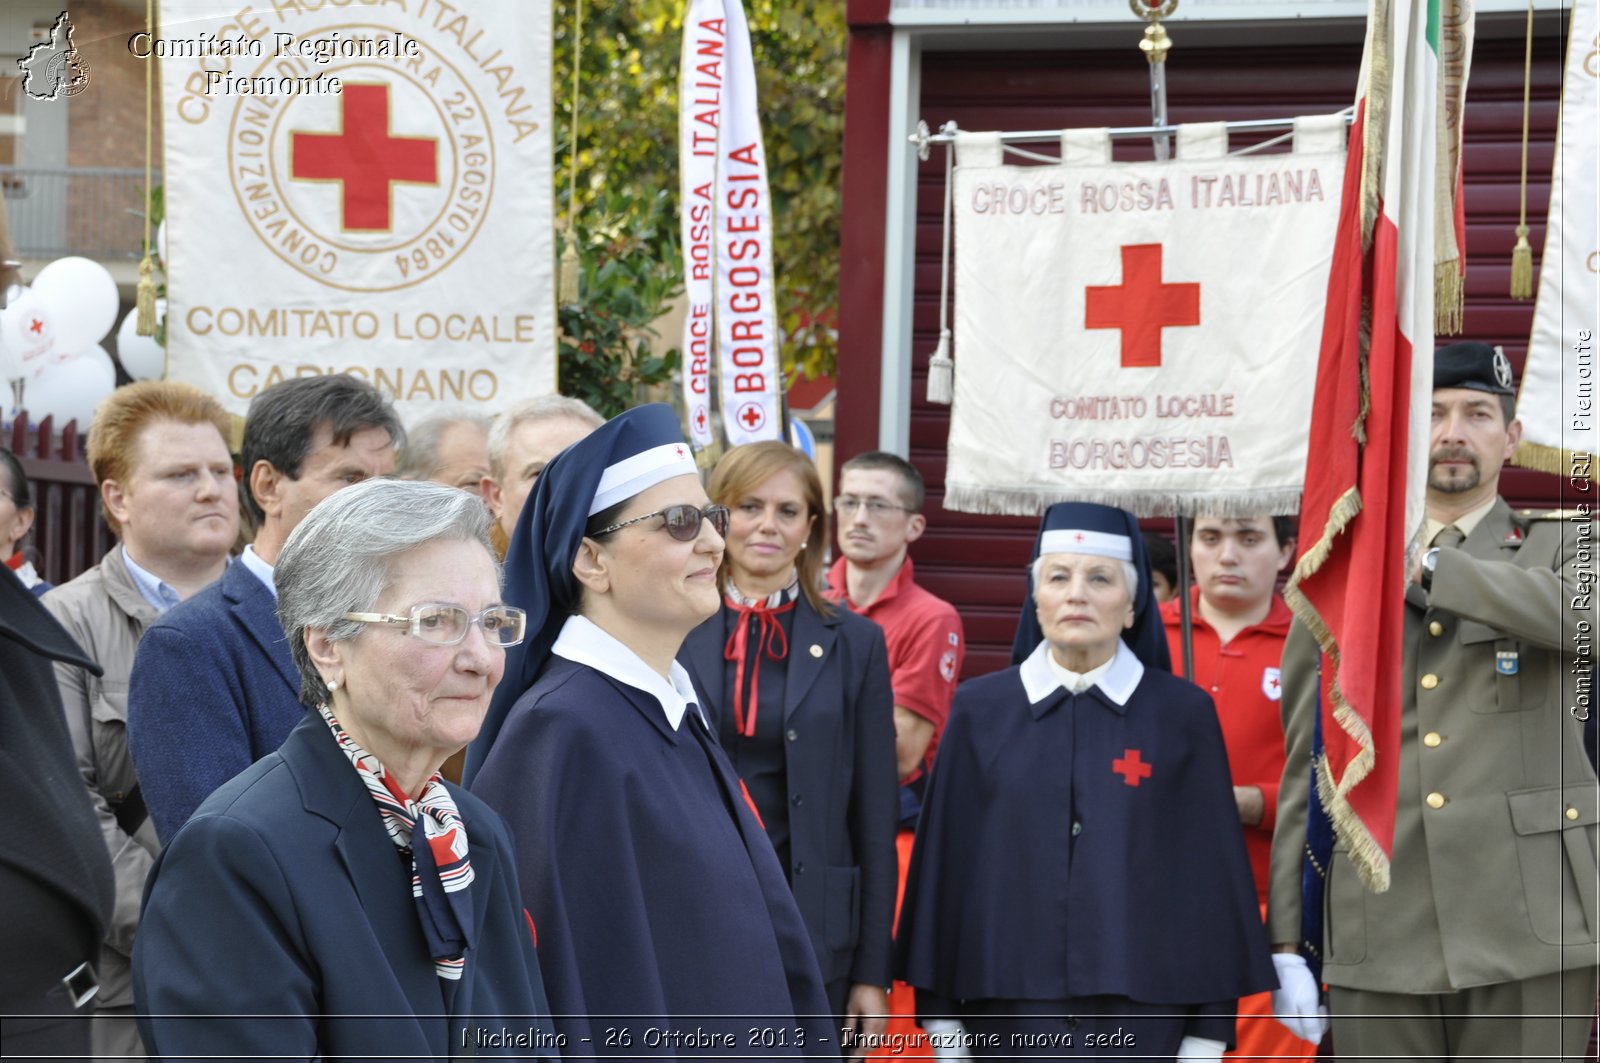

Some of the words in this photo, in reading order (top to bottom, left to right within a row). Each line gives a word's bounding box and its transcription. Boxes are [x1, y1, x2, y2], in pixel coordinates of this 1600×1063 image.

[443, 91, 475, 125] 22
[693, 18, 725, 156] ITALIANA
[448, 133, 488, 232] AGOSTO
[972, 182, 1065, 216] CROCE
[1081, 178, 1175, 214] ROSSA
[1191, 169, 1324, 210] ITALIANA
[395, 231, 455, 278] 1864
[690, 182, 712, 280] ROSSA
[727, 143, 766, 394] BORGOSESIA
[186, 306, 380, 340] COMITATO
[394, 312, 535, 343] LOCALE
[690, 303, 709, 395] CROCE
[1050, 396, 1147, 420] COMITATO
[1156, 393, 1235, 418] LOCALE
[1048, 435, 1234, 471] BORGOSESIA
